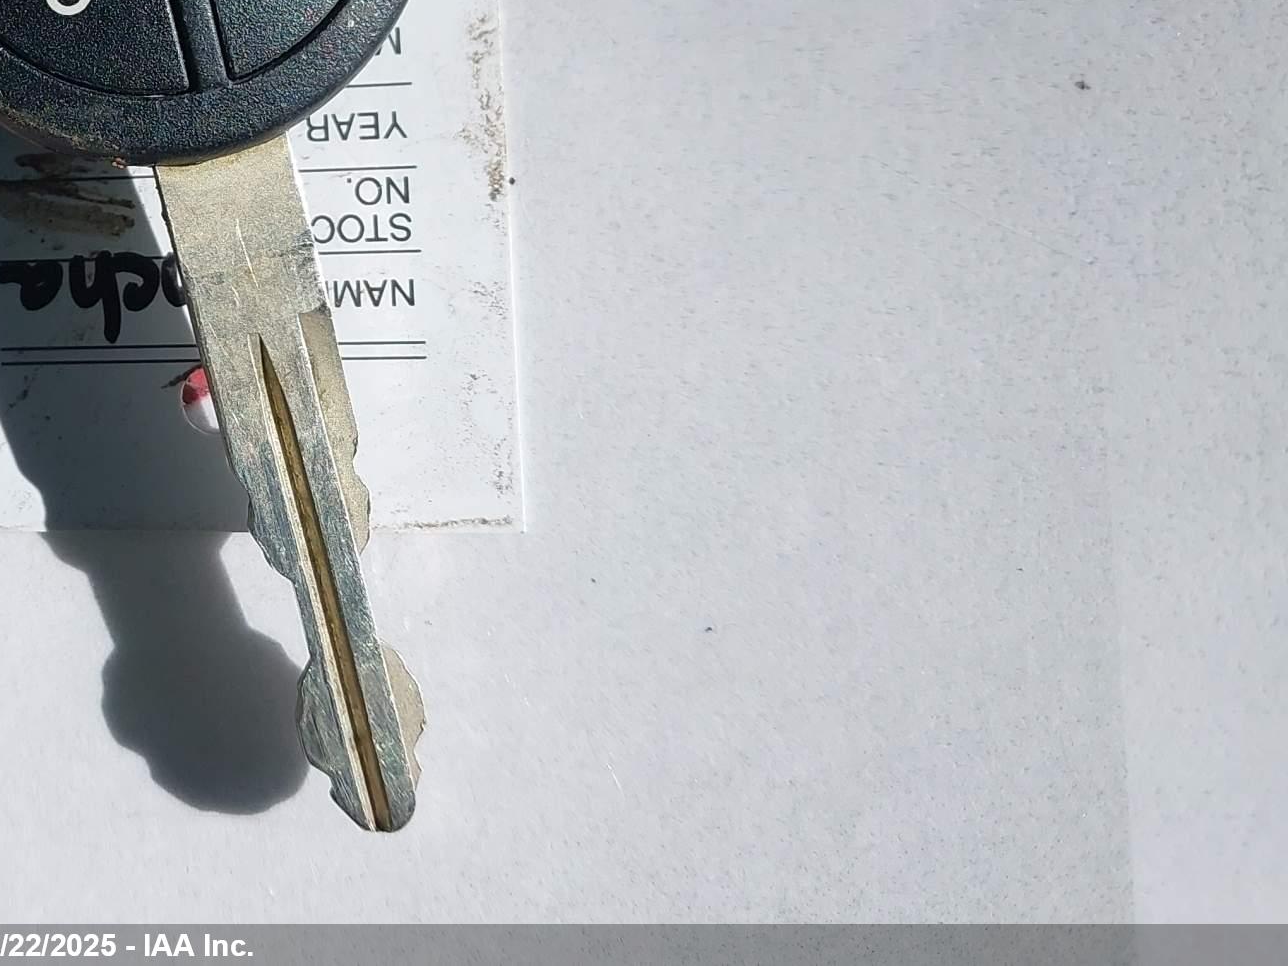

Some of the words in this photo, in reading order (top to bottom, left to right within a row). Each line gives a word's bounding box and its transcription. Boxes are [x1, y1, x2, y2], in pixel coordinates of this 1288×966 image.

[306, 111, 408, 141] YEAR
[346, 176, 410, 206] NO.
[312, 213, 412, 244] STOC
[325, 279, 416, 308] NAM
